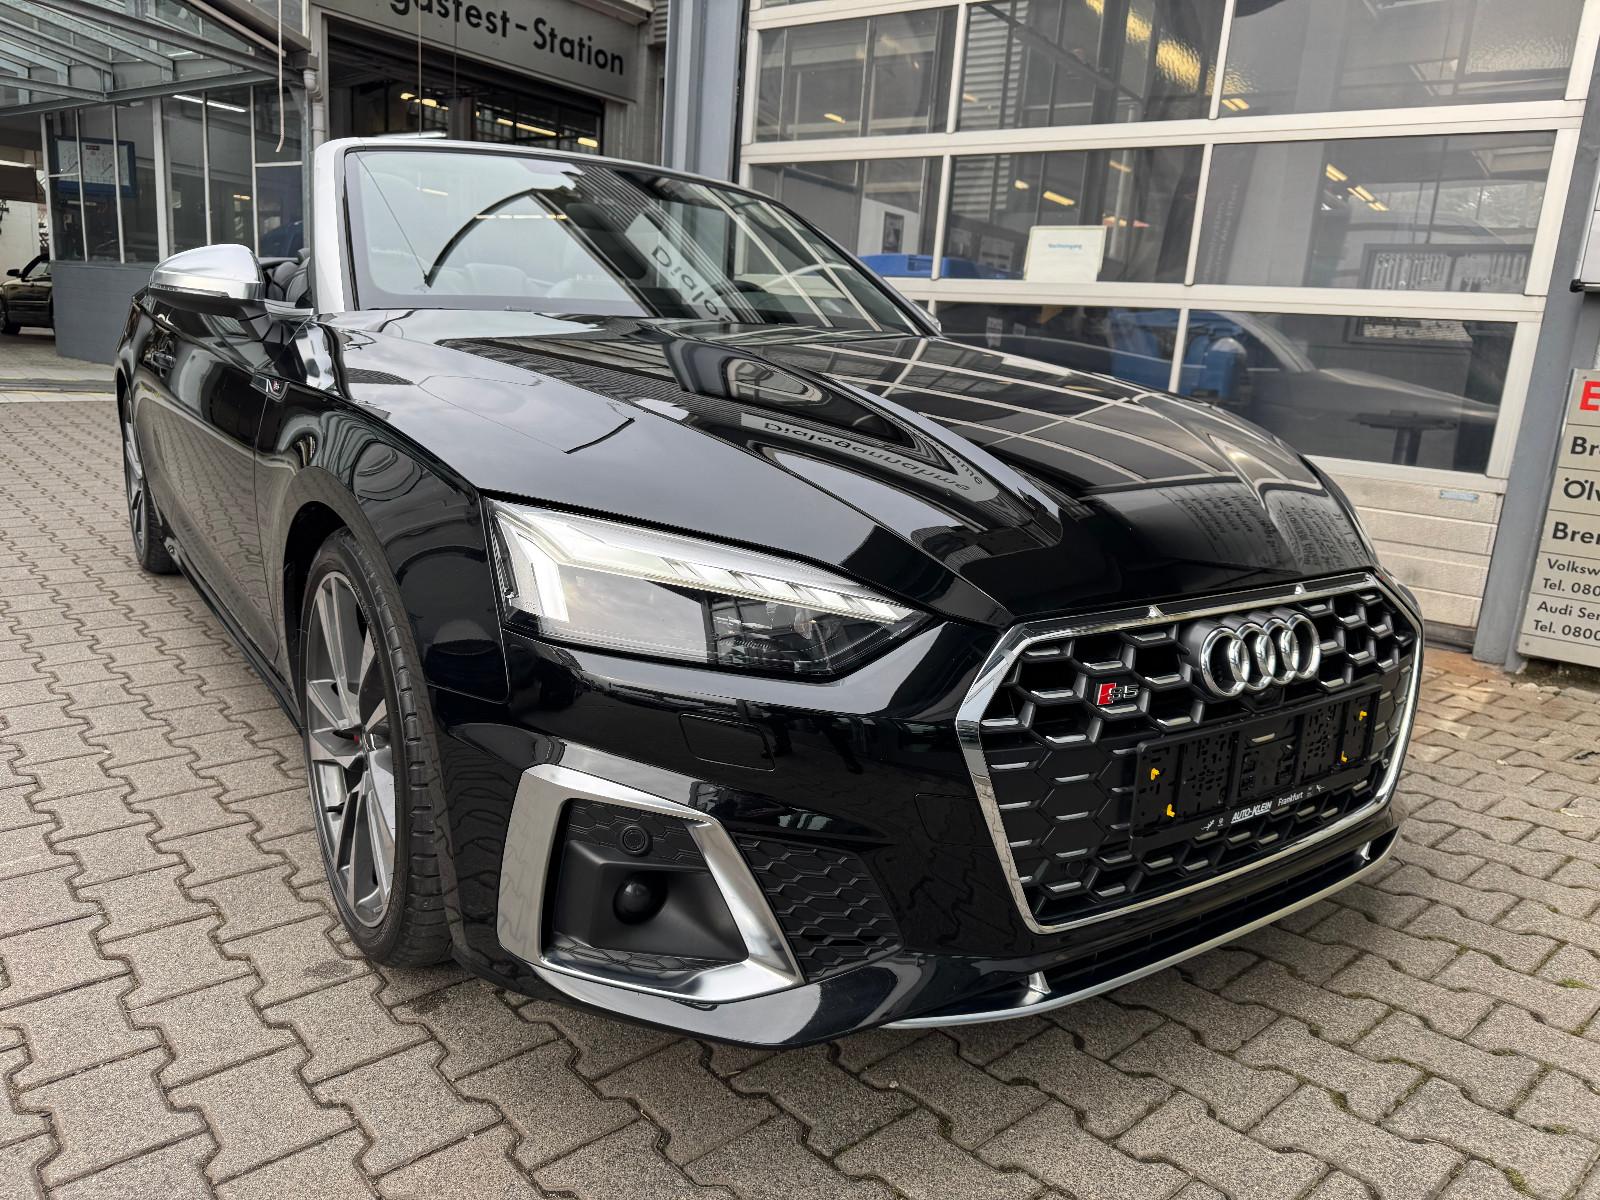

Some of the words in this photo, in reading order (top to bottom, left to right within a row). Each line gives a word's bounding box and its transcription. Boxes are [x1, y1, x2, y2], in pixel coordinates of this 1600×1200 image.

[1571, 436, 1600, 456] Br
[1543, 578, 1565, 592] Tel.
[1537, 601, 1573, 616] Audi
[1533, 619, 1556, 634] Tel.
[1106, 684, 1139, 702] S5
[1232, 801, 1272, 823] AUTO-KLEIN
[1278, 791, 1304, 807] Frankfurt
